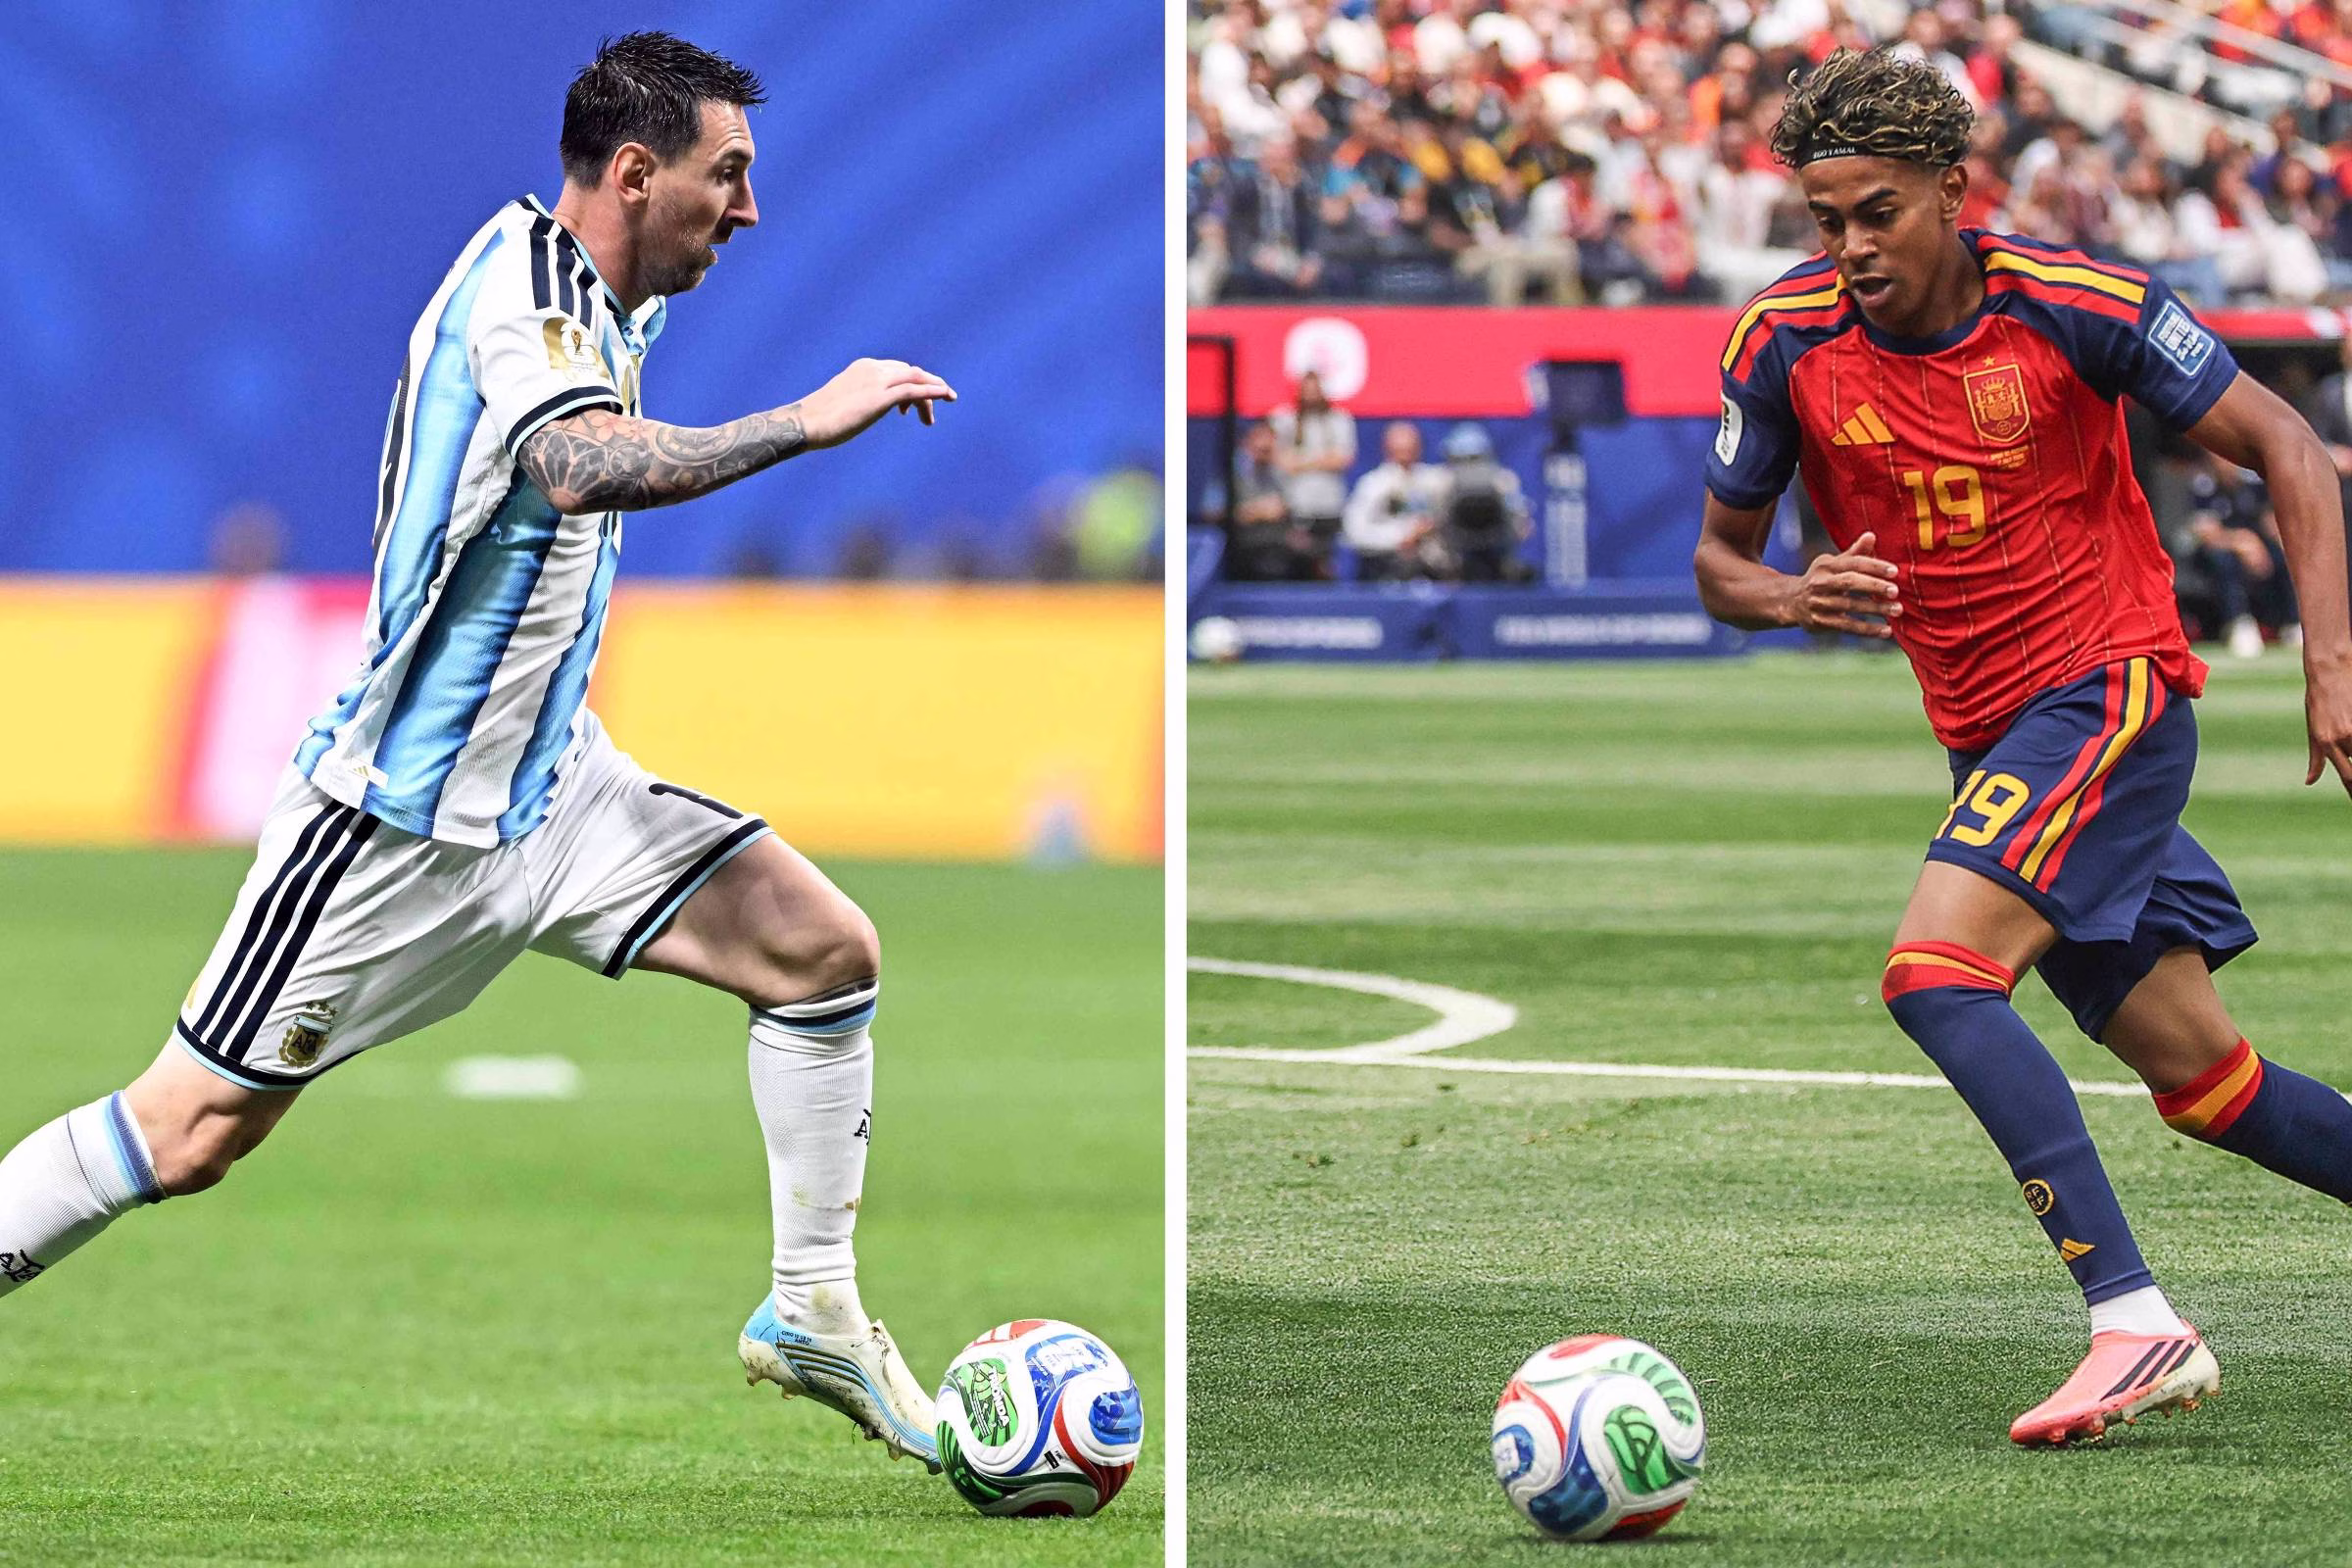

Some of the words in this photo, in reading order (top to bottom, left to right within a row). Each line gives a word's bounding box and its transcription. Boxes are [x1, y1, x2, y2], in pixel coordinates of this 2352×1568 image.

[1828, 146, 1857, 157] YAMAL
[1903, 465, 1987, 552] 19
[1936, 769, 2032, 847] 19
